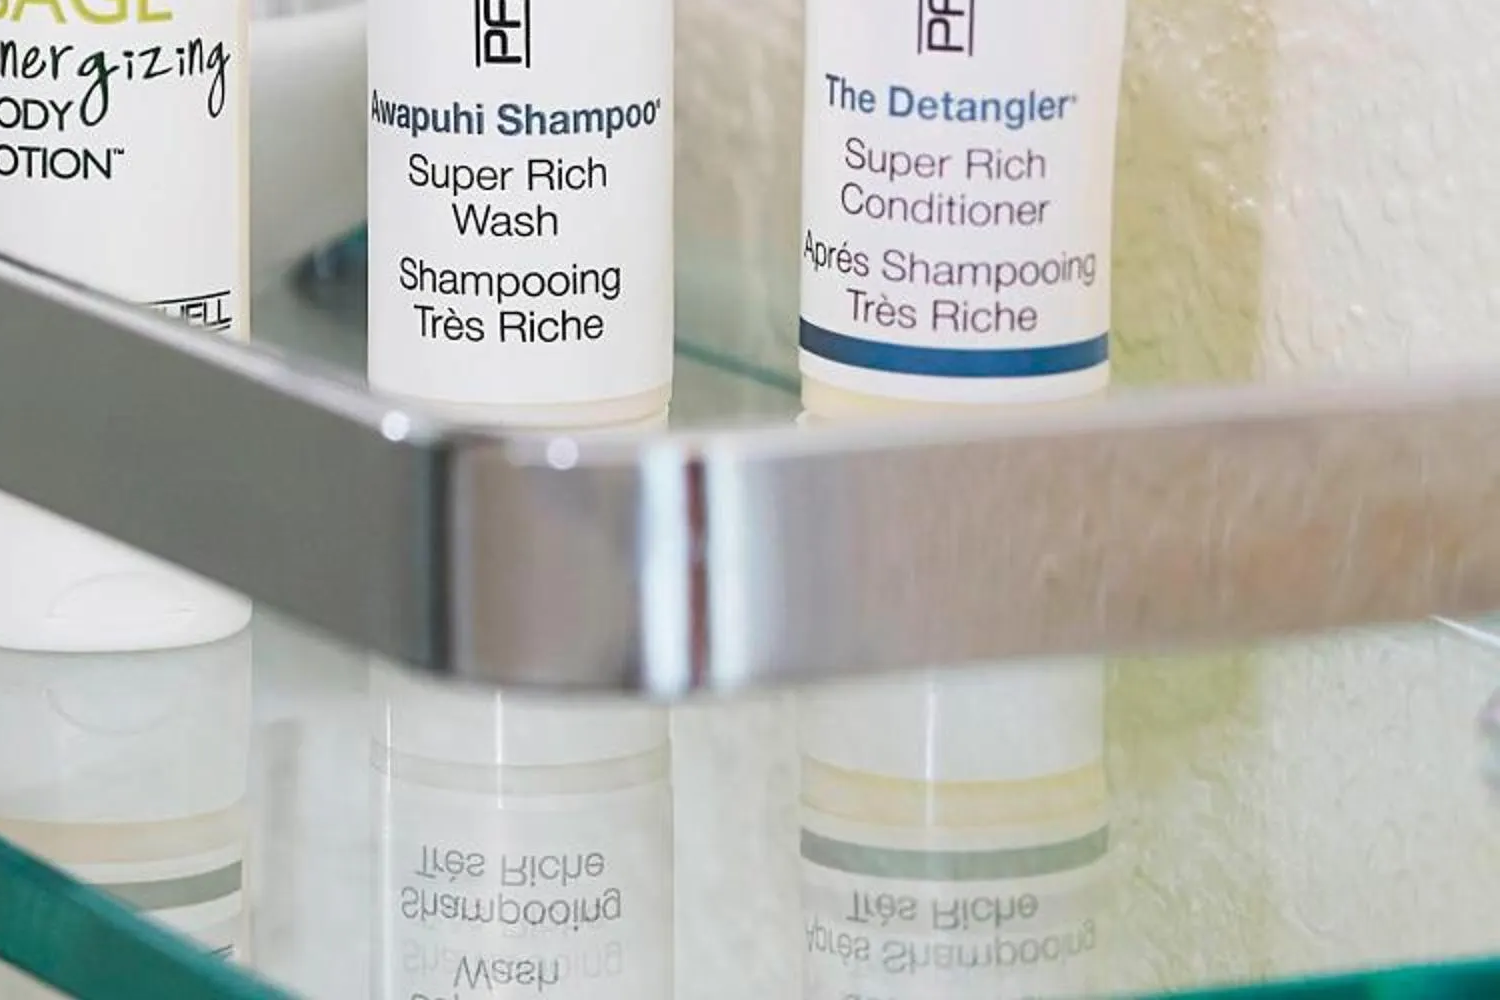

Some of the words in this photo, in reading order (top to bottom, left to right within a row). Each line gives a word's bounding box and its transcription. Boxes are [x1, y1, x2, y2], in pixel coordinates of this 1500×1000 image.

[372, 89, 485, 138] Awapuhi
[825, 72, 876, 115] The
[408, 152, 514, 197] Super
[527, 157, 607, 191] Rich
[844, 136, 952, 182] Super
[965, 147, 1047, 181] Rich
[452, 203, 558, 237] Wash
[840, 182, 1051, 227] Conditioner
[399, 256, 622, 304] Shampooing
[803, 228, 870, 278] Aprés
[881, 248, 1098, 293] Shampooing
[414, 304, 485, 342] Très
[499, 310, 605, 343] Riche
[846, 287, 917, 330] Très
[931, 298, 1039, 334] Riche
